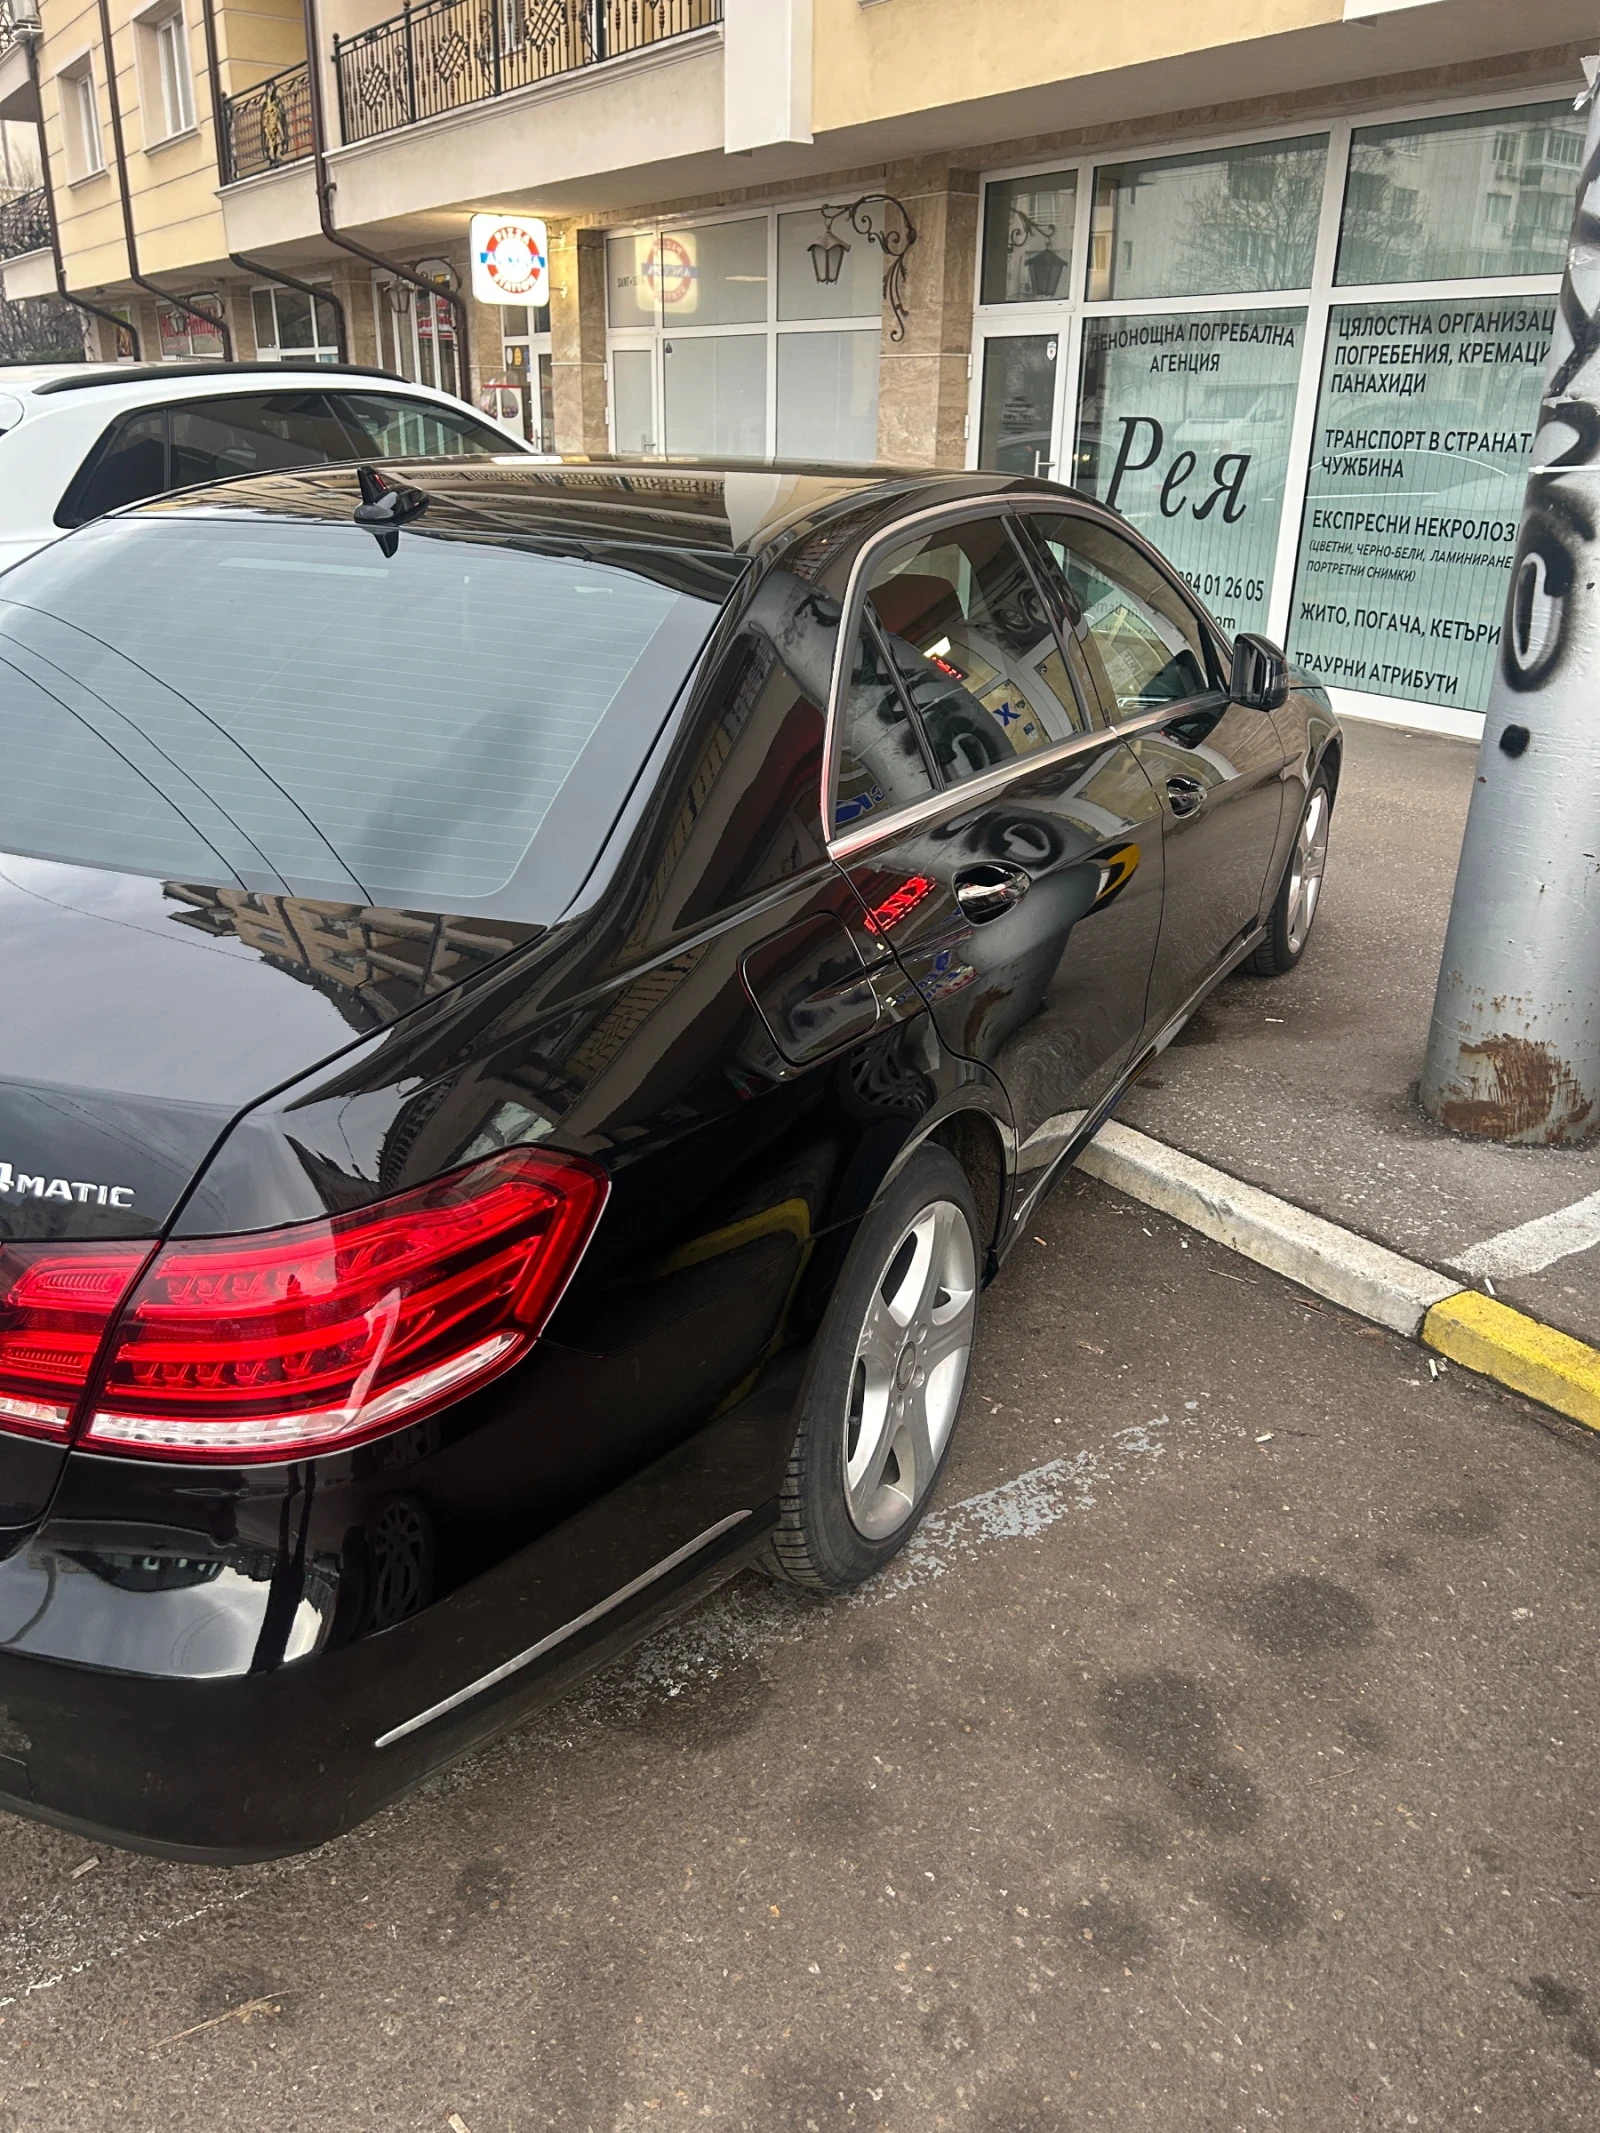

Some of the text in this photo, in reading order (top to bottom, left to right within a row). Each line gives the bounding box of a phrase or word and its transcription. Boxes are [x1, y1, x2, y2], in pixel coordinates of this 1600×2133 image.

[493, 227, 532, 246] PIZZA
[492, 272, 540, 293] STATION
[1189, 322, 1295, 348] ПОГРЕБАЛНА
[1338, 315, 1433, 340] ЦЯЛОСТНА
[1150, 353, 1221, 375] АГЕНЦИЯ
[1334, 343, 1453, 367] ПОГРЕБЕНИЯ,
[1331, 373, 1427, 397] ПАНАХИДИ
[1325, 429, 1426, 451] ТРАНСПОРТ
[1428, 431, 1440, 451] В
[1105, 416, 1252, 524] Рея
[1322, 456, 1404, 478] ЧУЖБИНА
[1312, 509, 1520, 542] ЕКСПРЕСНИ НЕКРОЛОЗ
[1309, 539, 1514, 571] (ЦВЕТНИ, ЧЕРНО-БЕЛИ, ЛАМИНИРАНЕ,
[1306, 560, 1416, 583] ПОРТРЕТНИ СНИМКИ)
[1204, 574, 1220, 597] 01
[1225, 576, 1243, 600] 26
[1246, 579, 1265, 602] 05
[1300, 602, 1502, 645] ЖИТО, ПОГАЧА, КЕТЪРИ
[1295, 651, 1459, 695] ТРАУРНИ АТРИБУТИ
